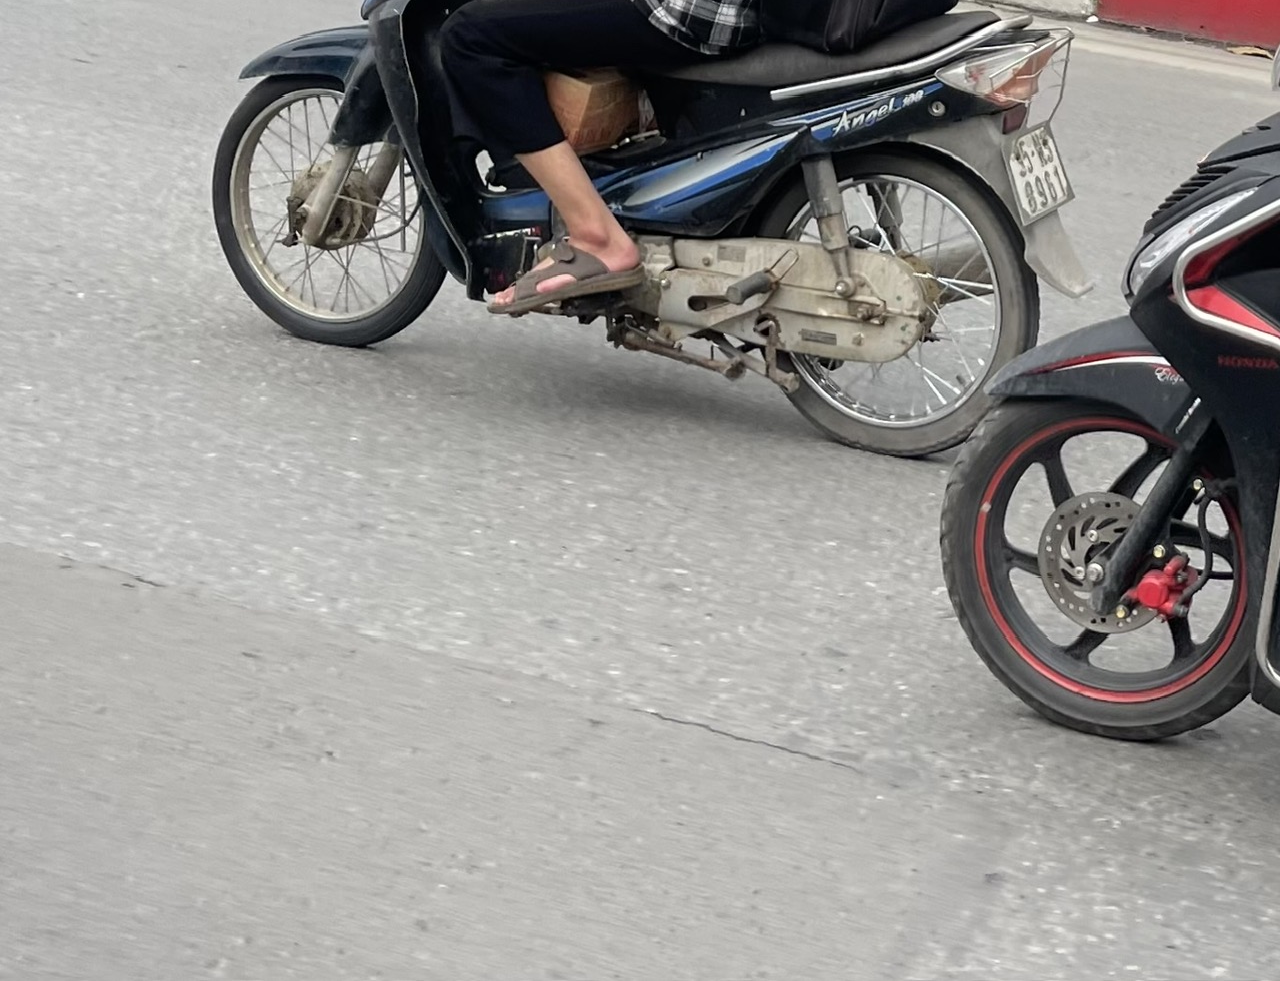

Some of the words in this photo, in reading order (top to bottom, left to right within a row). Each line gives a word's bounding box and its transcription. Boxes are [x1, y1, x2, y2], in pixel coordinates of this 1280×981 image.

[832, 97, 902, 138] Angel
[1025, 165, 1067, 213] 8961
[1217, 354, 1280, 370] HONDA
